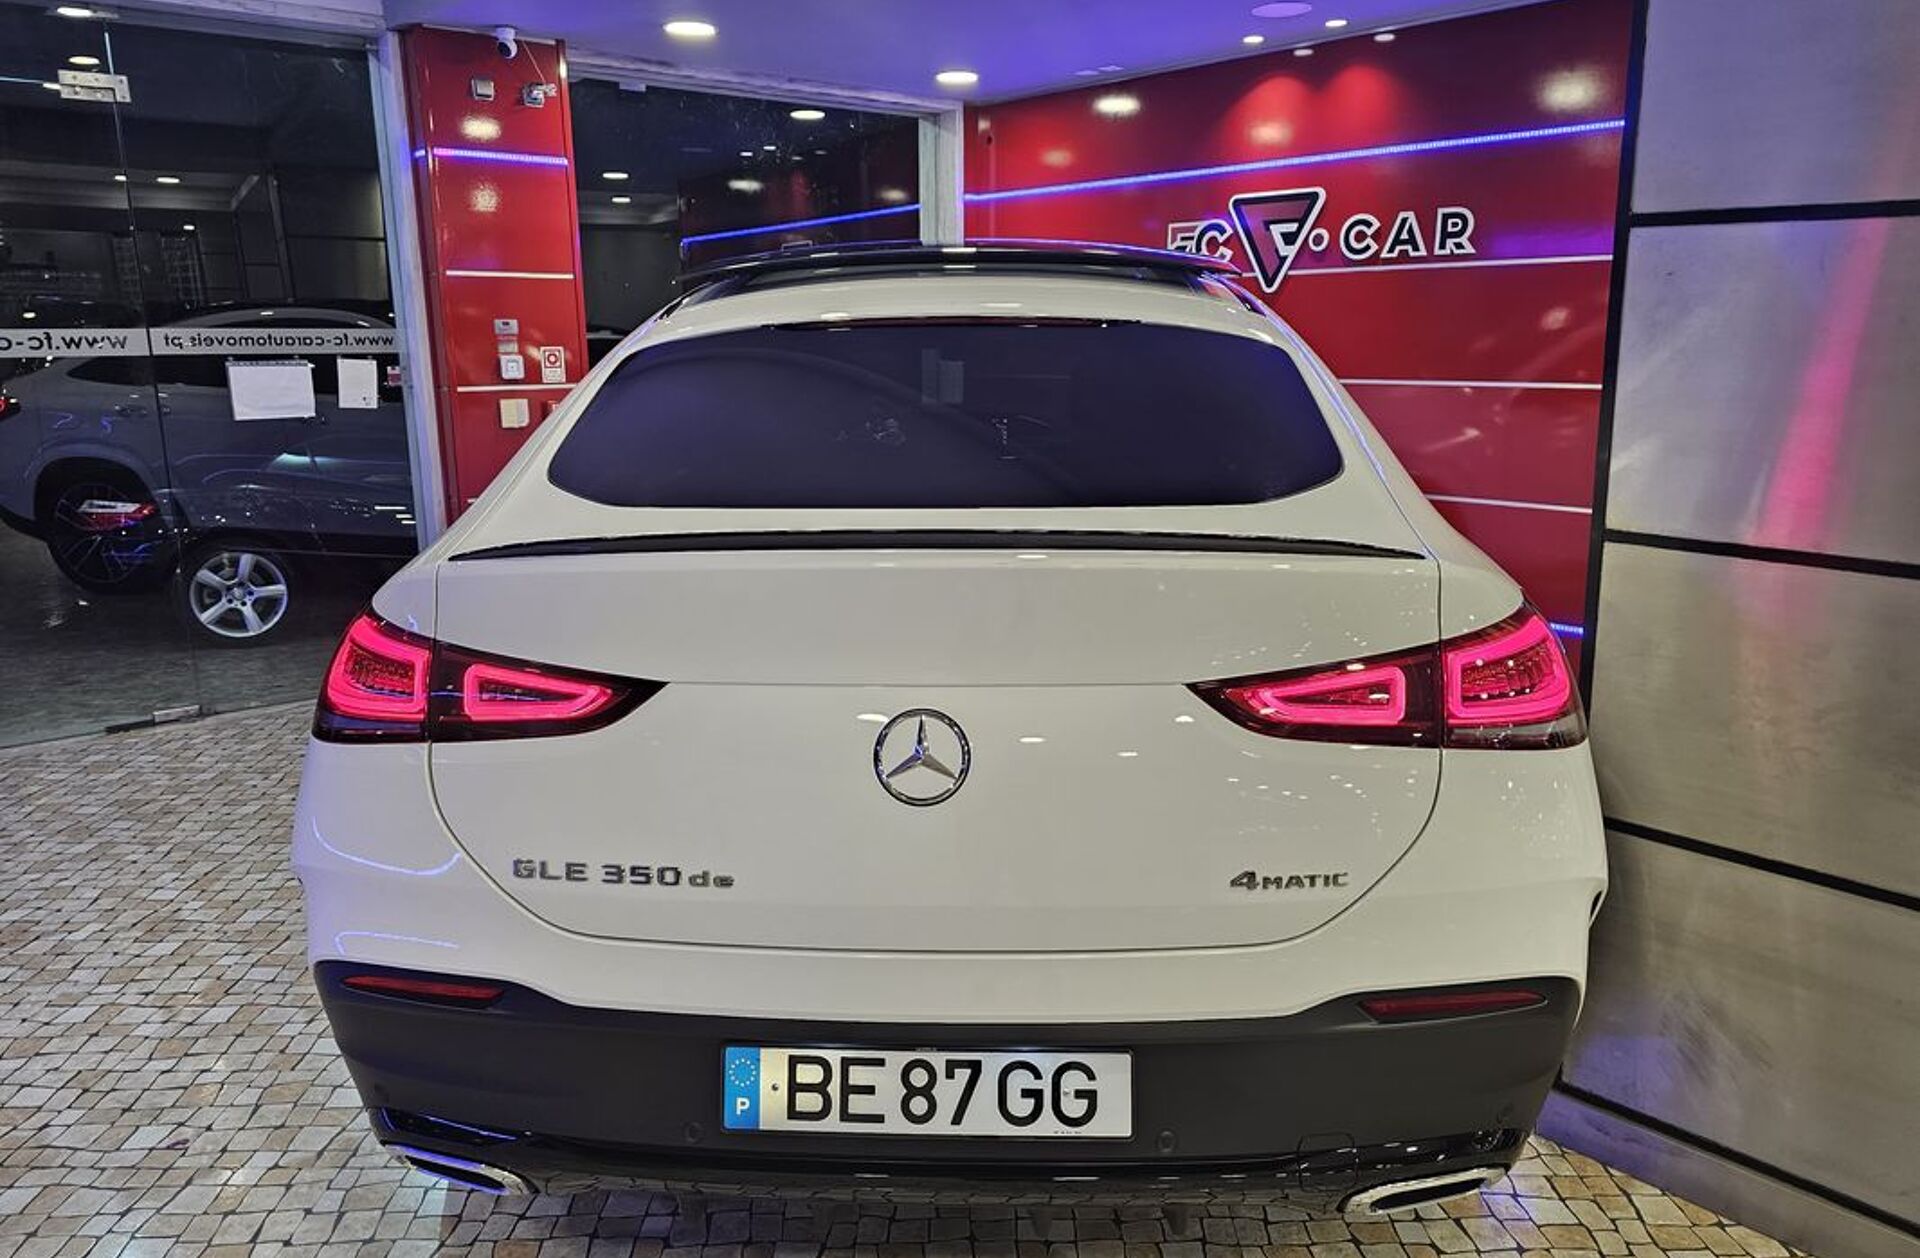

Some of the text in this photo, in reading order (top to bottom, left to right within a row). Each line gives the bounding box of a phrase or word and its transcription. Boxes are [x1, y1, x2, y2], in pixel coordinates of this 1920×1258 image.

[1339, 205, 1476, 261] CAR
[512, 858, 589, 882] GLE
[1229, 870, 1349, 890] 4MATIC
[786, 1054, 1099, 1128] BE 87 GG
[735, 1097, 750, 1115] P
